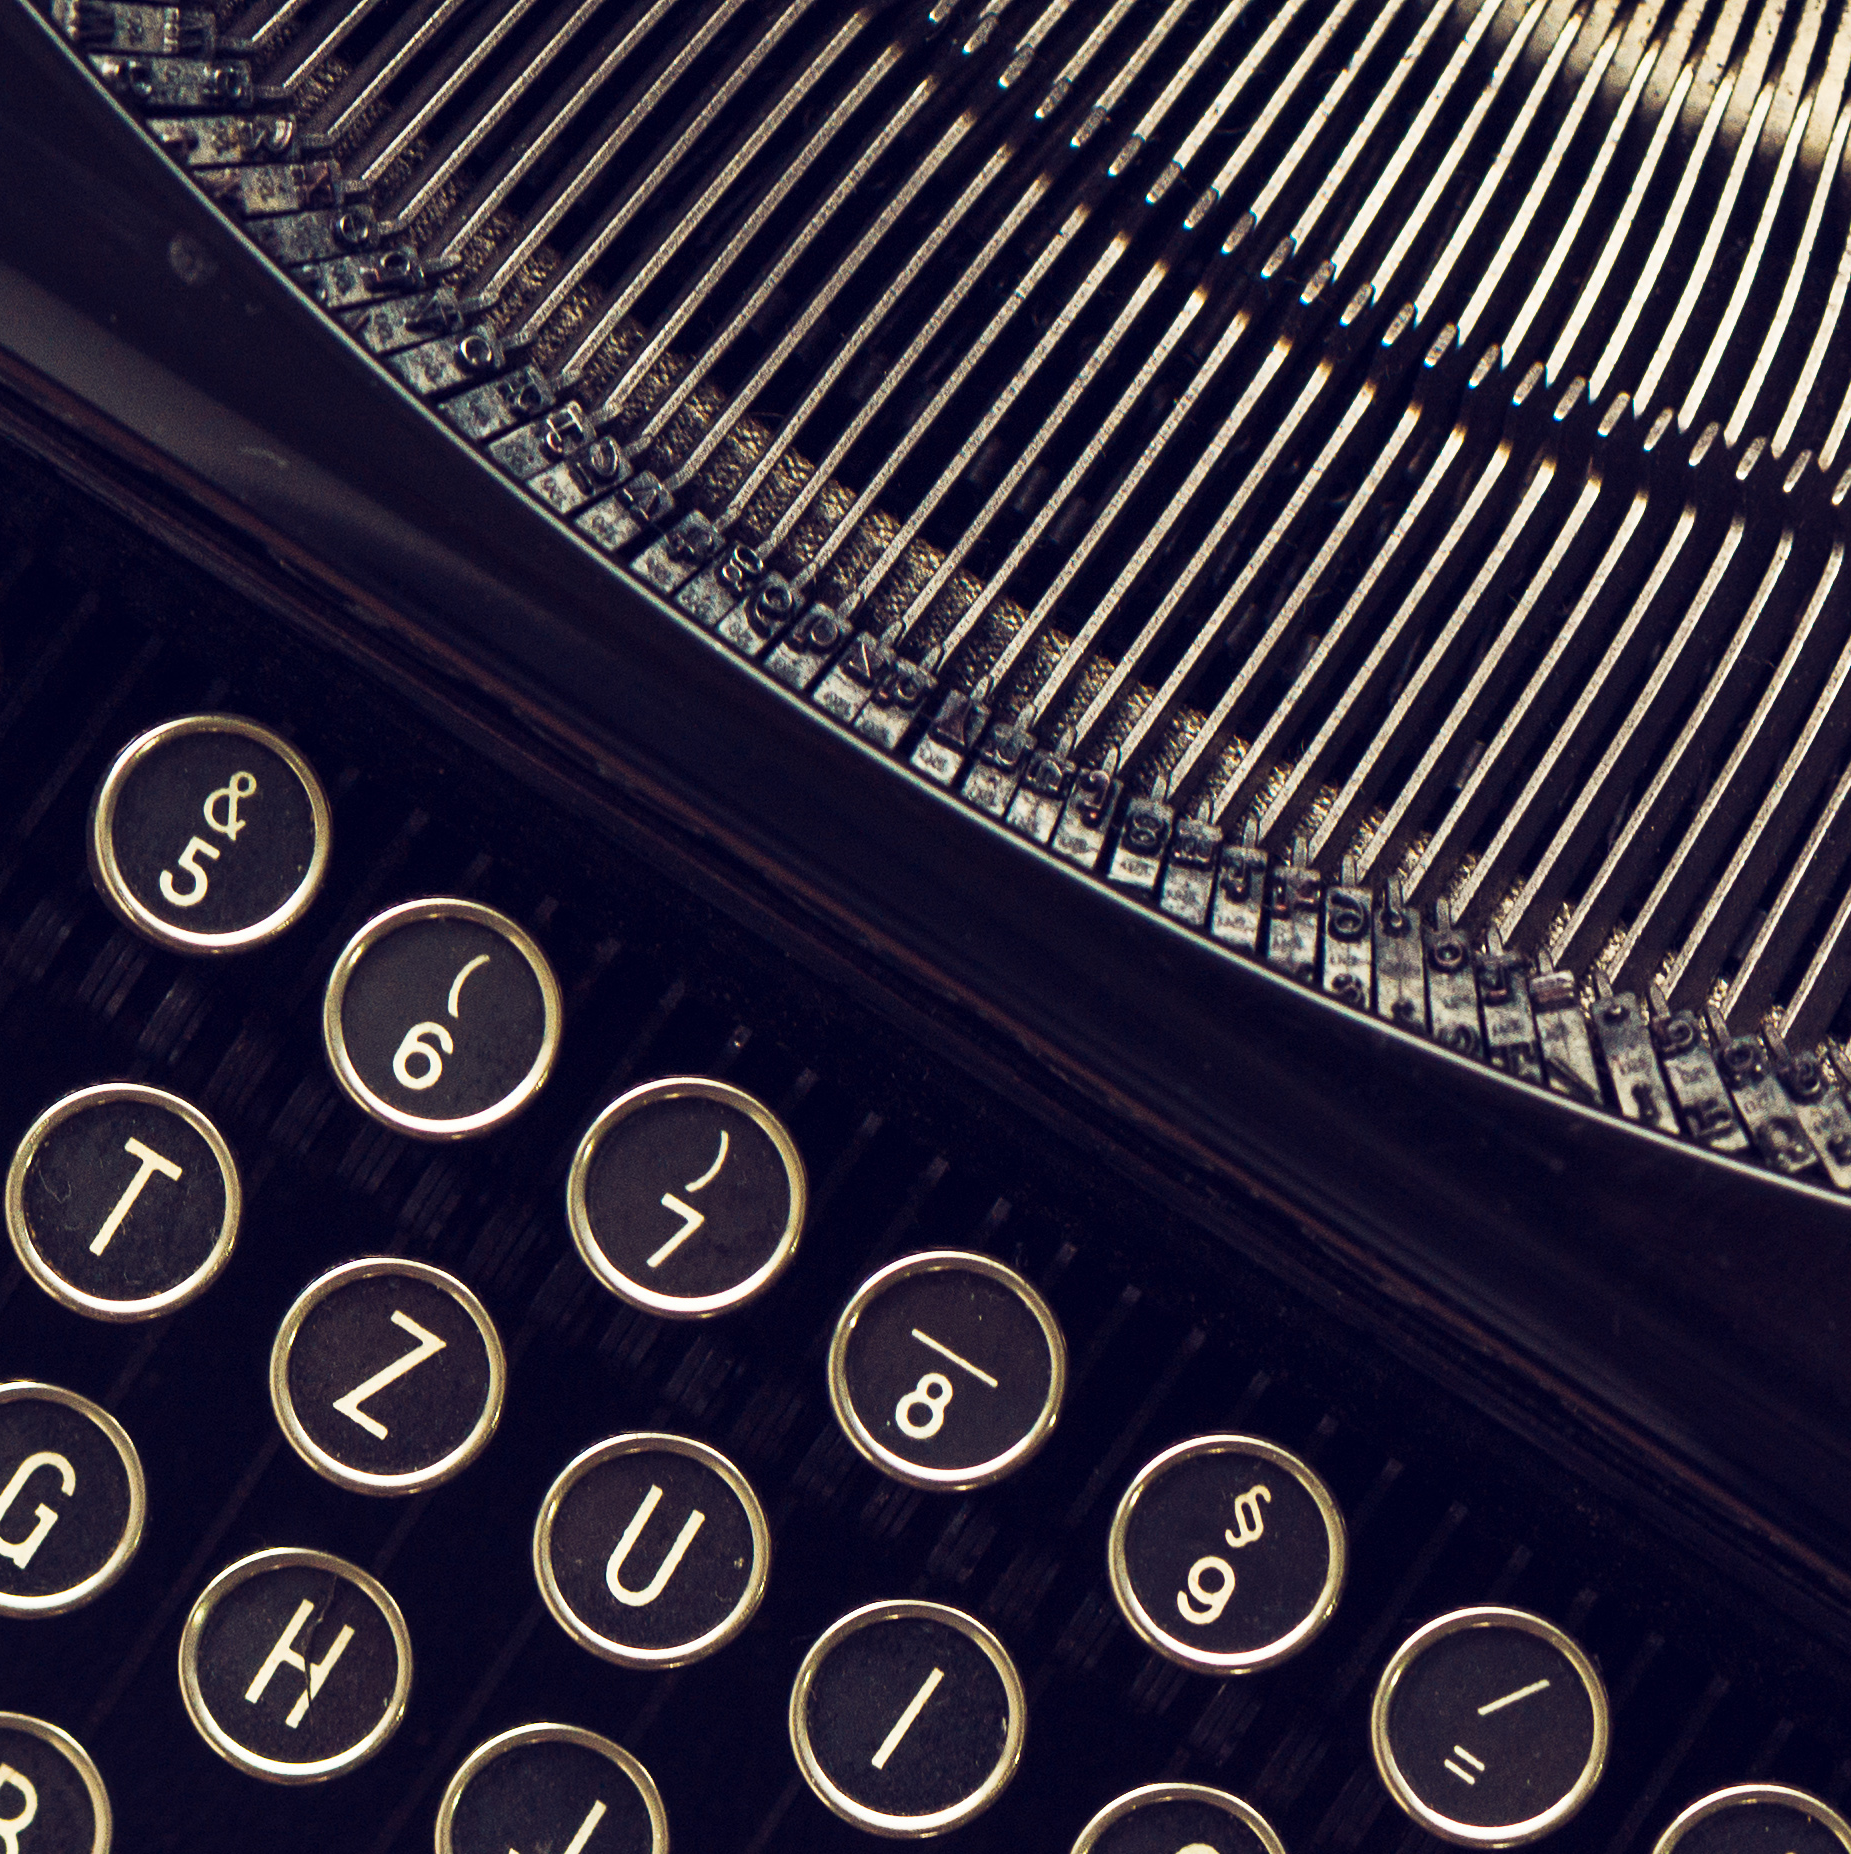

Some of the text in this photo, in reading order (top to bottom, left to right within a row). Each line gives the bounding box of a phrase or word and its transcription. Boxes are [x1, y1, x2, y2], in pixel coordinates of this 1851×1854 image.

[202, 770, 258, 843] &
[158, 834, 222, 909] 5
[446, 953, 491, 1020] (
[391, 1020, 455, 1092] 6
[87, 1135, 184, 1258] T
[683, 1129, 730, 1194] )
[645, 1191, 706, 1269] 7
[331, 1308, 448, 1442] Z
[893, 1371, 955, 1441] 8
[604, 1483, 707, 1608] U
[1175, 1554, 1237, 1626] 9
[243, 1597, 356, 1730] H
[870, 1666, 946, 1771] I
